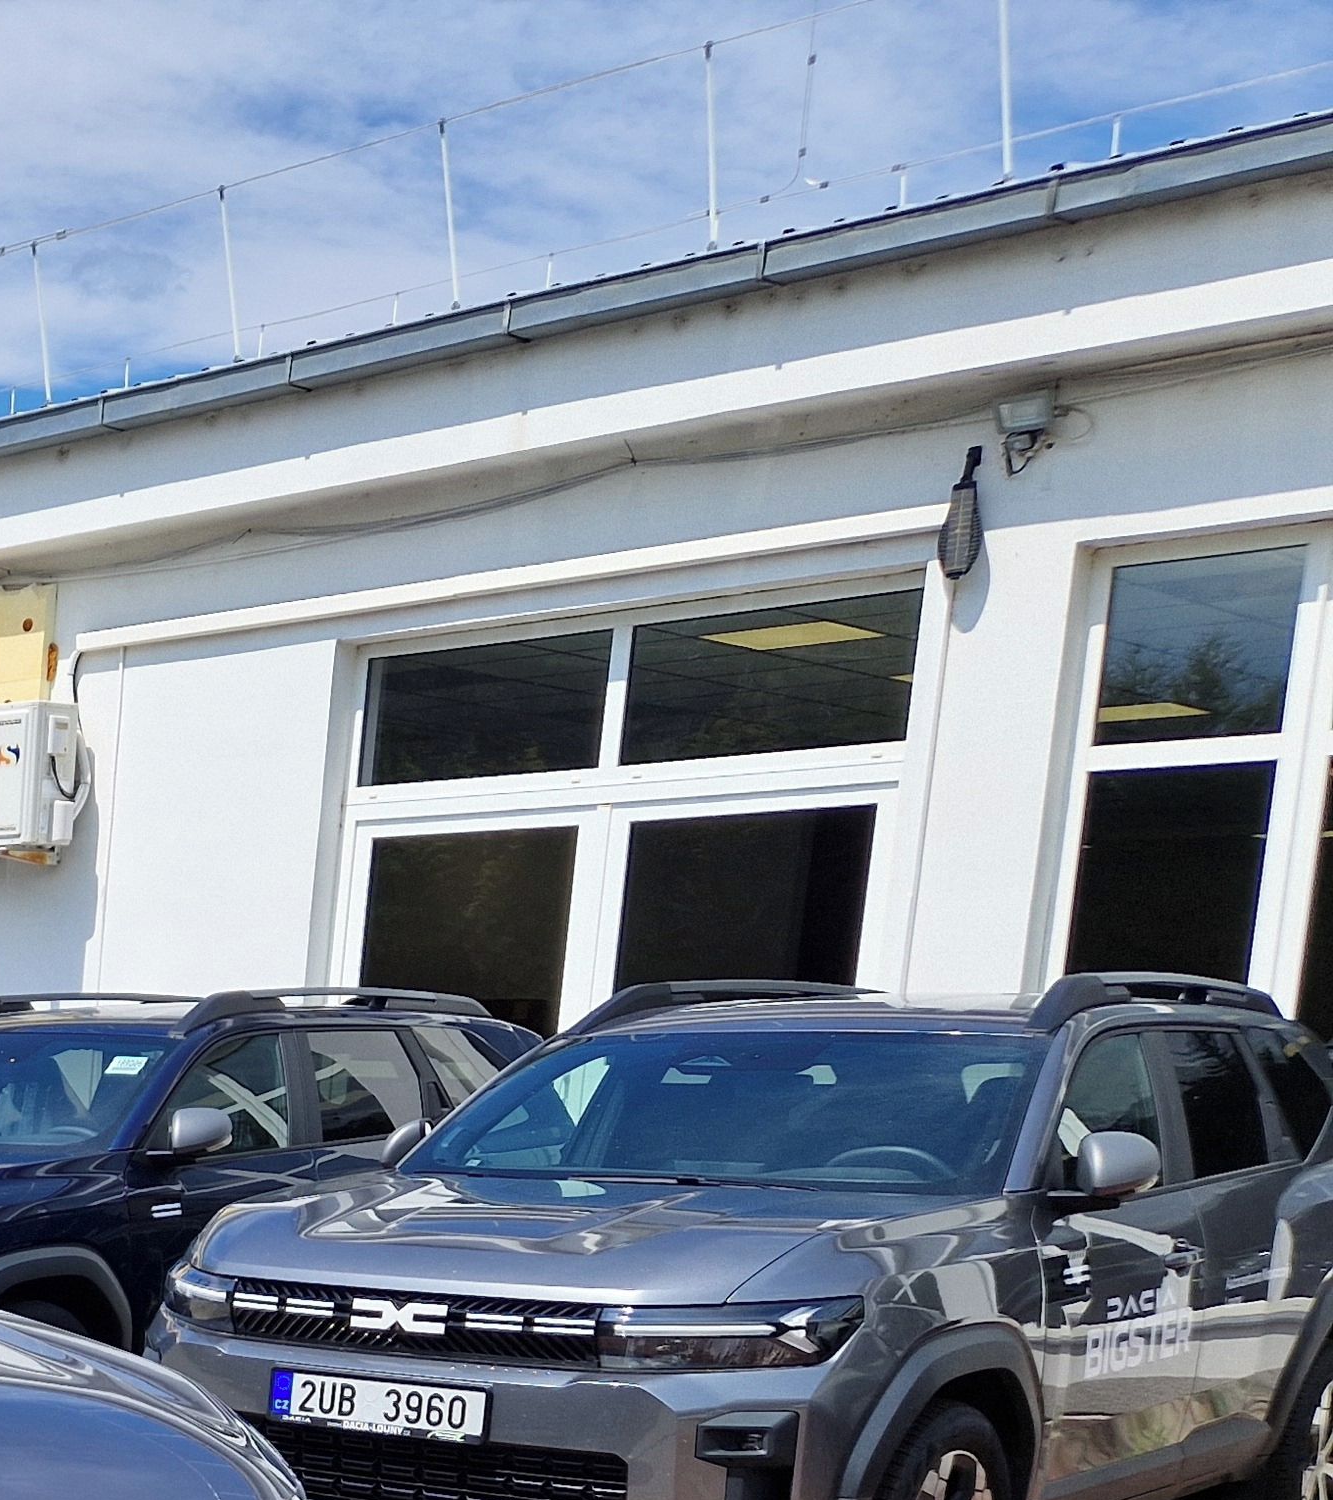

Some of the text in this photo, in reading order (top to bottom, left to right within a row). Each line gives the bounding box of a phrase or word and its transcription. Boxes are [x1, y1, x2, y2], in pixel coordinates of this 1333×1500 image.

[1106, 1288, 1176, 1320] DACIA
[1084, 1312, 1191, 1379] BIGSTER
[274, 1398, 289, 1410] CZ
[281, 1414, 312, 1424] DACIA
[298, 1379, 467, 1430] 2UB 3960
